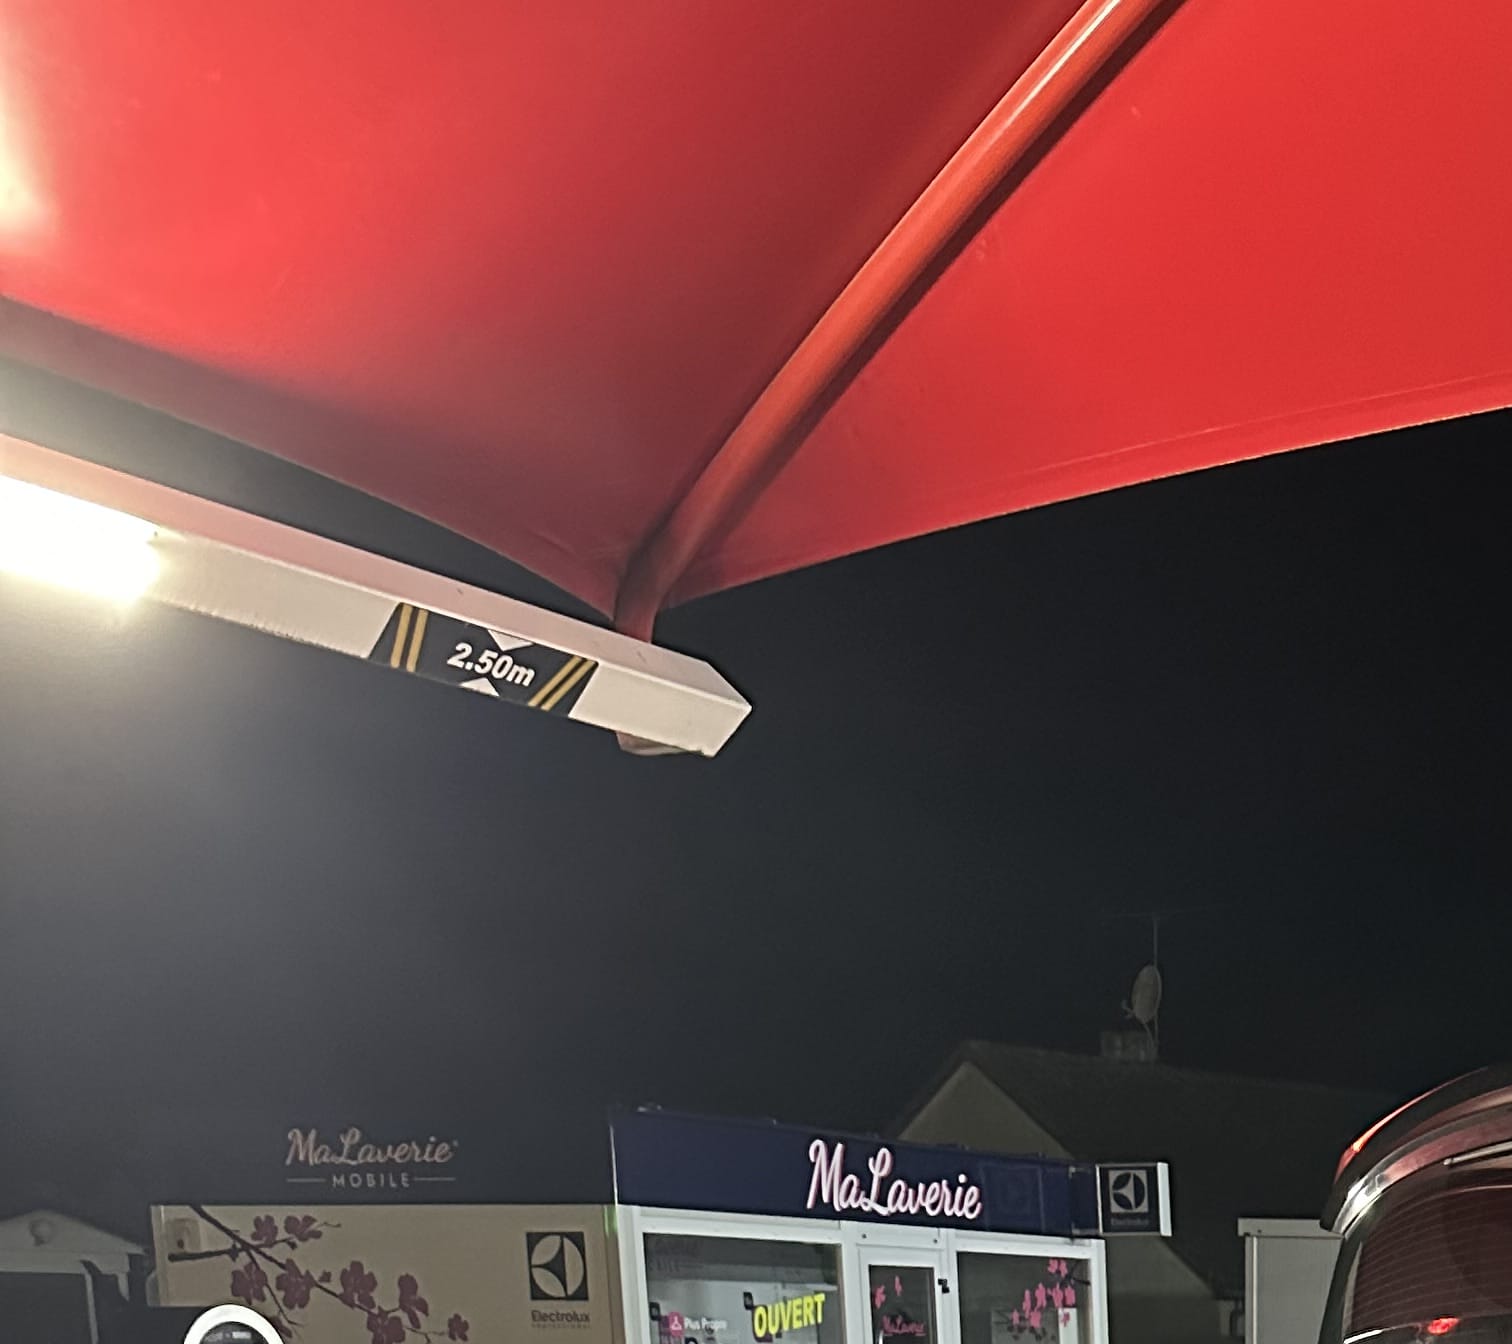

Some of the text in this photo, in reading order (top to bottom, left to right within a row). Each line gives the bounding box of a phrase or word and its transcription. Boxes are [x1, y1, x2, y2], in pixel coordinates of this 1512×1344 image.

[446, 641, 536, 687] 2.50m
[332, 1172, 410, 1188] MOBILE
[806, 1138, 983, 1220] MaLaverie
[753, 1292, 826, 1339] OUVERT
